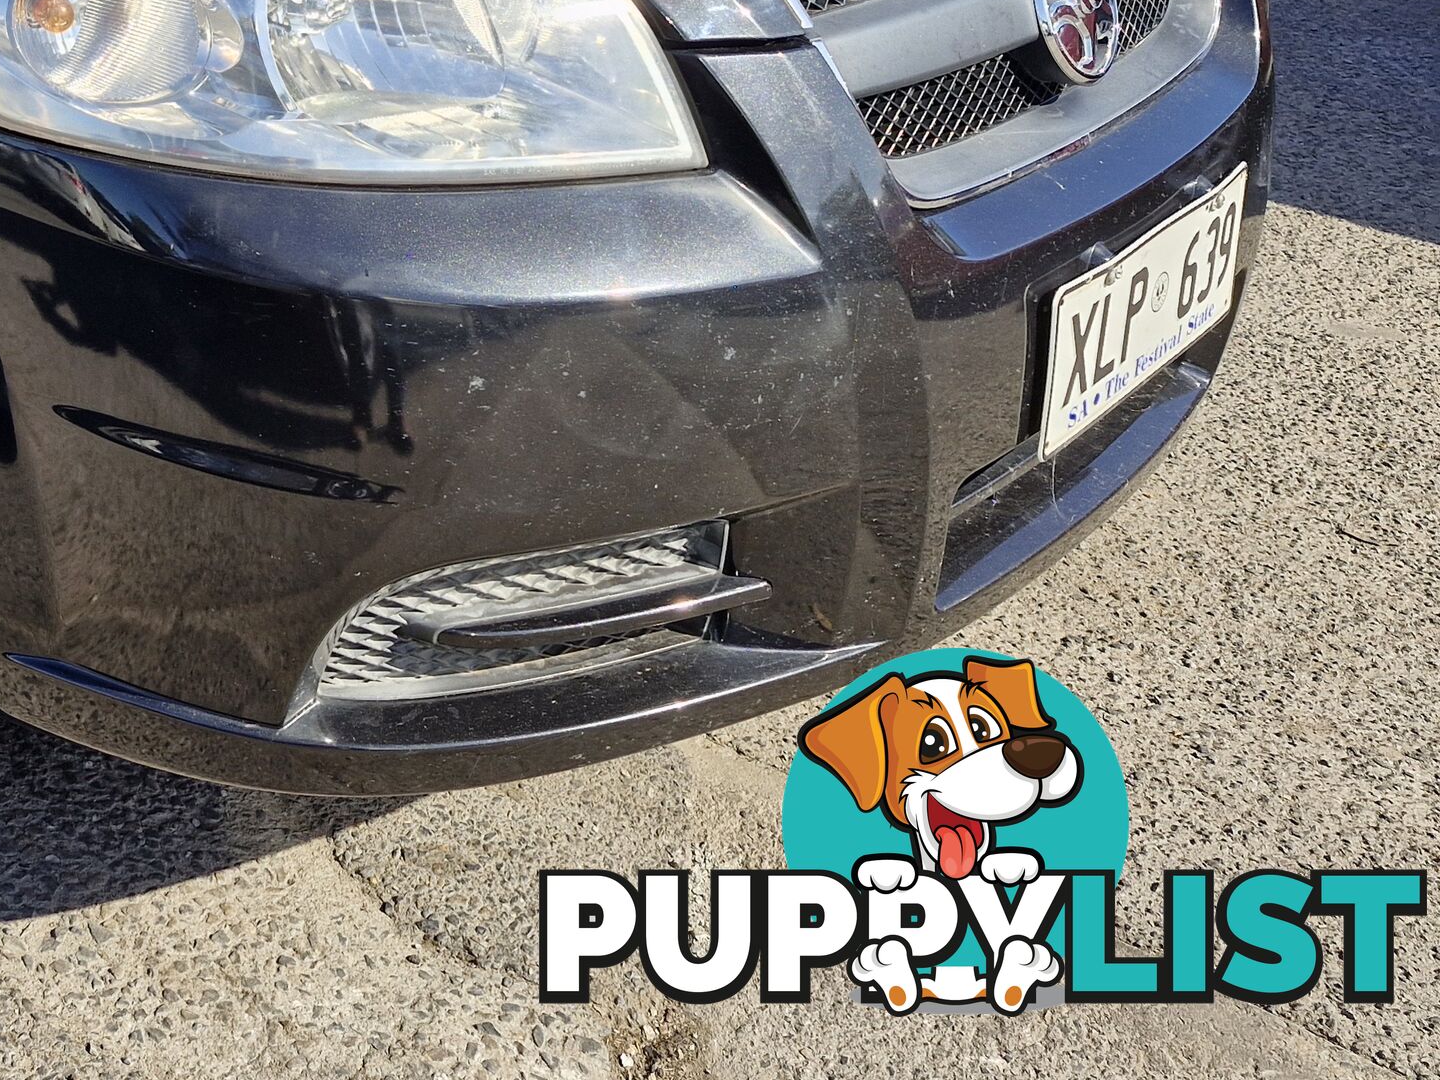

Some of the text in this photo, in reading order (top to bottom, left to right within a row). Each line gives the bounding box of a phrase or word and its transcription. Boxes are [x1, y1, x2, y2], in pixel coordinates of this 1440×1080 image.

[1061, 202, 1236, 409] XLP 639
[1067, 302, 1215, 428] SA The Festival State
